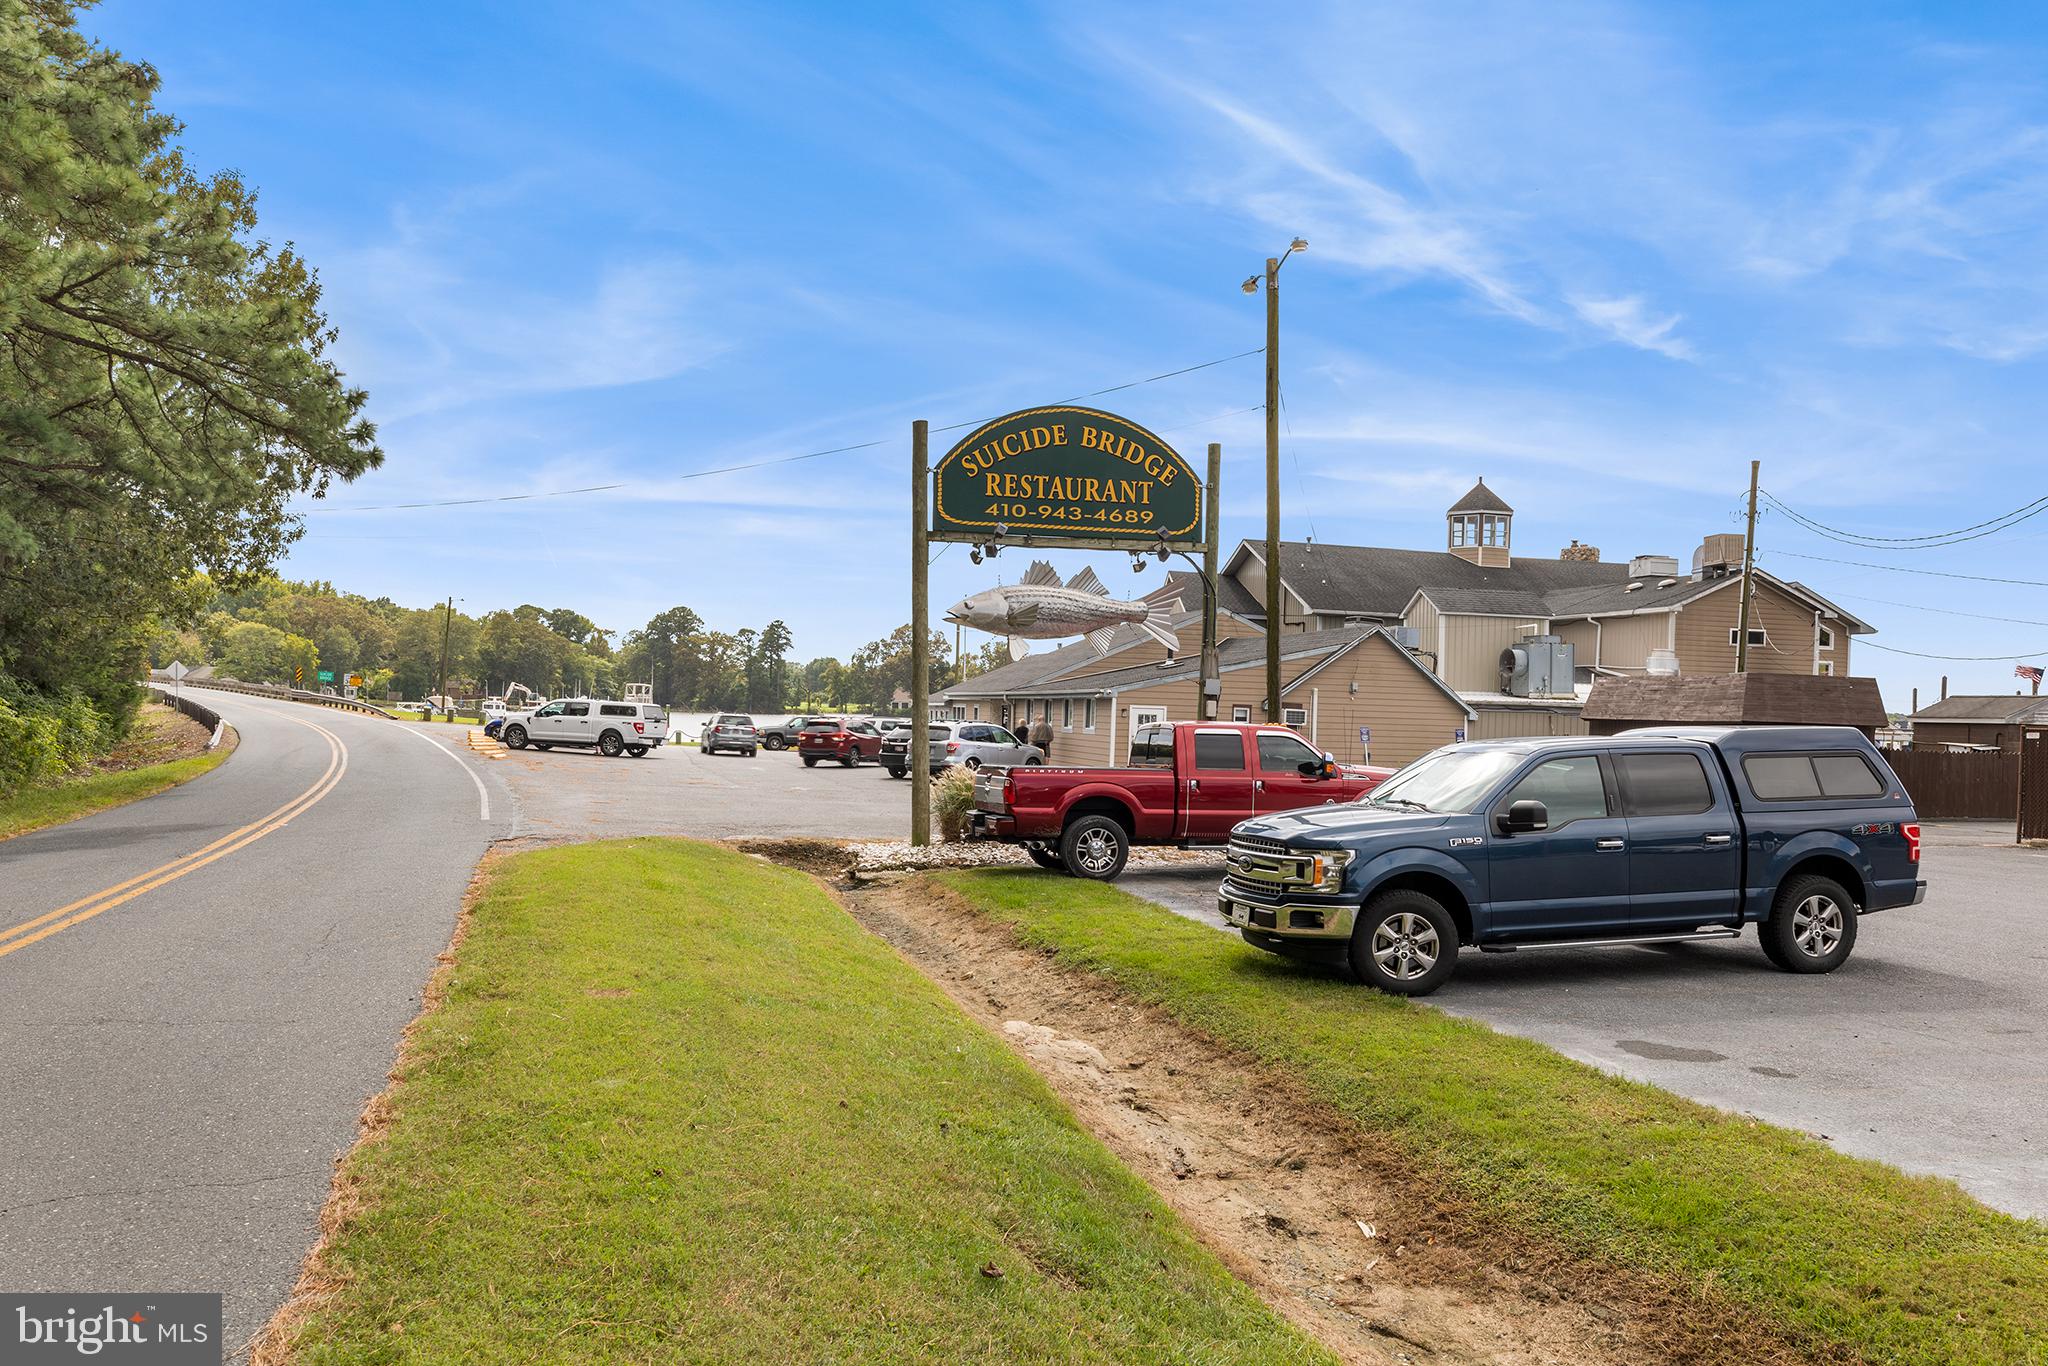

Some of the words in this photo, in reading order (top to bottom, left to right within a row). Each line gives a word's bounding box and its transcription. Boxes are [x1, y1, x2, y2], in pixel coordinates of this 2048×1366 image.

[960, 424, 1069, 478] SUICIDE
[1080, 425, 1179, 487] BRIDGE
[985, 472, 1154, 505] RESTAURANT
[985, 503, 1154, 524] 410-943-4689
